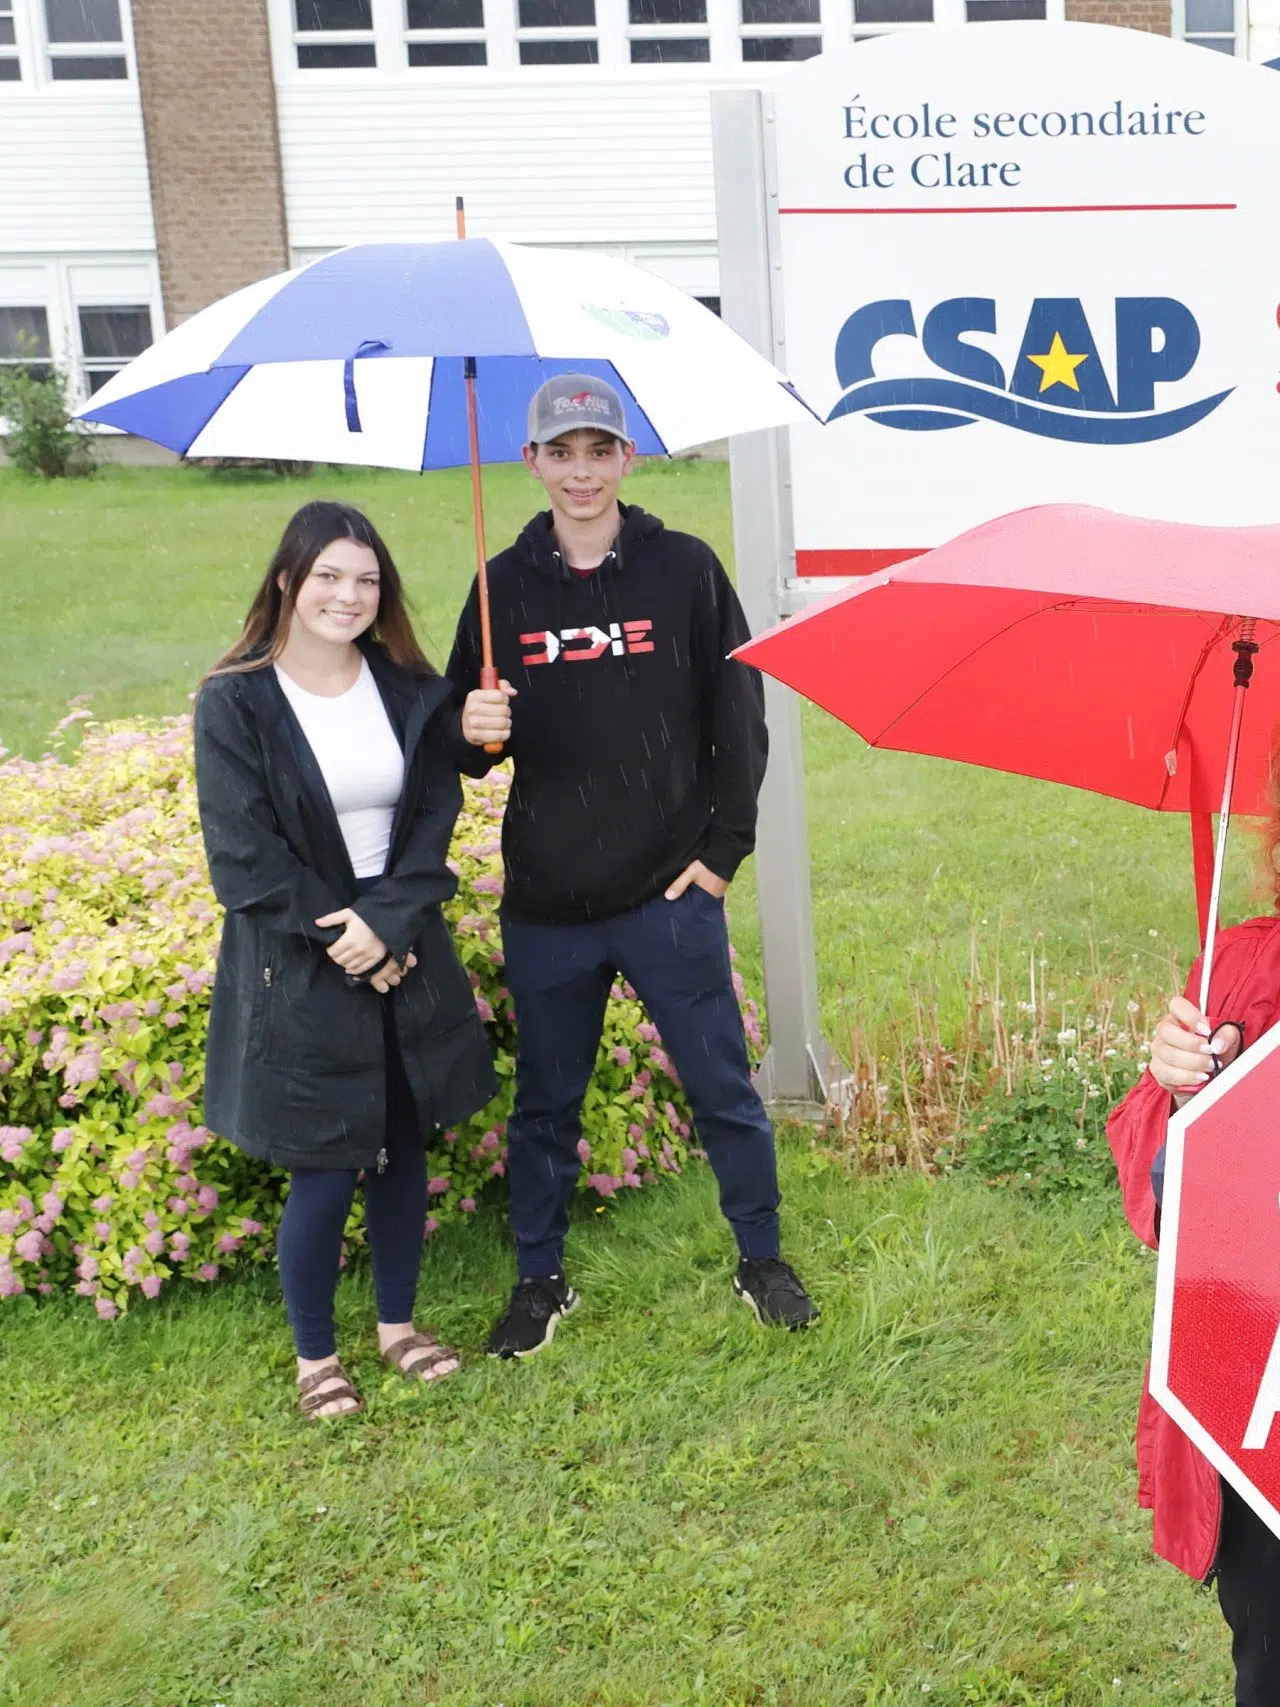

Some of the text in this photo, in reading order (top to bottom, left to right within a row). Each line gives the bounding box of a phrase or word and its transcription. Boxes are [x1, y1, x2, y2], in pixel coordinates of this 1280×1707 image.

[843, 94, 1206, 139] École secondaire
[843, 152, 1021, 189] de Clare
[834, 296, 1201, 413] CSAP
